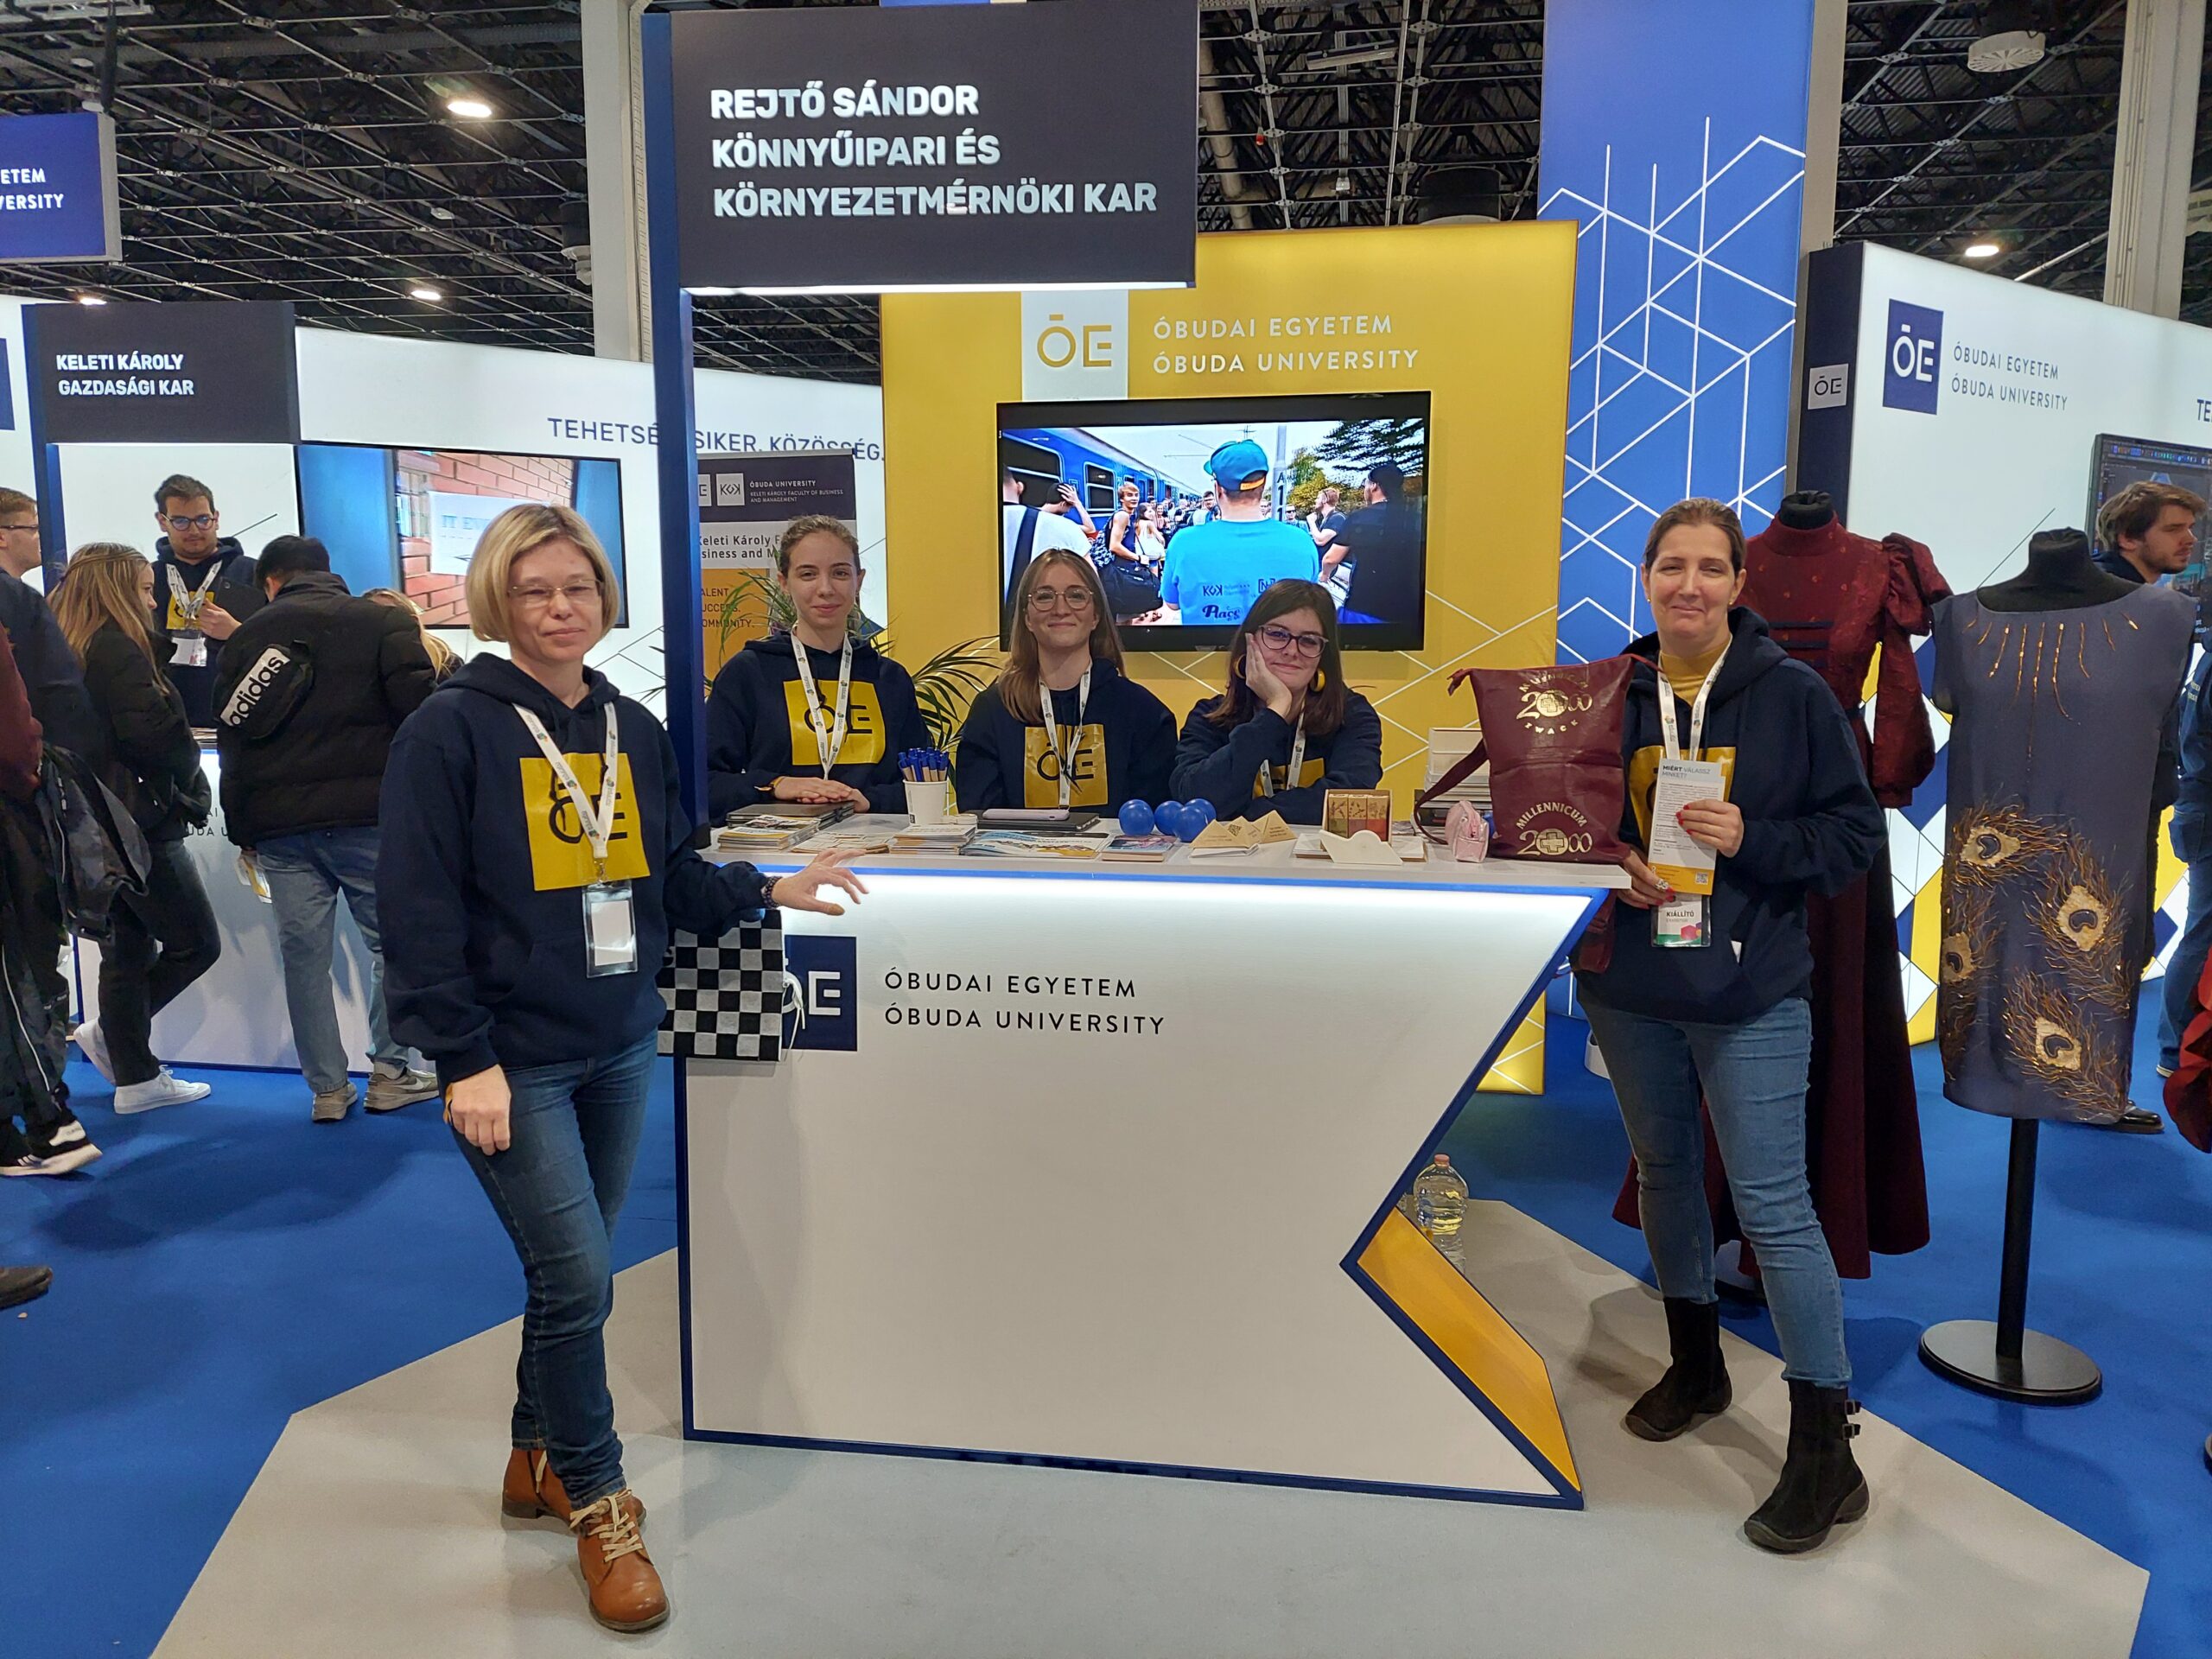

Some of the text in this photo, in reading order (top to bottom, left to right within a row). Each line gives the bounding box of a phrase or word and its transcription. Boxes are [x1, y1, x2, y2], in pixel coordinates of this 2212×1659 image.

[710, 79, 979, 119] REJTŐ SÁNDOR
[712, 129, 1001, 168] KÖNNYŰIPARI ÉS
[0, 168, 46, 184] ETEM
[714, 178, 1157, 217] KÖRNYEZETMÉRNÖKI KAR
[1154, 315, 1392, 340] ÓBUDAI EGYETEM
[56, 351, 183, 370] KELETI KÁROLY
[1154, 349, 1419, 373] ÓBUDA UNIVERSITY
[1954, 341, 2058, 380] ÓBUDAI EGYETEM
[58, 377, 194, 395] GAZDASÁGI KAR
[1951, 372, 2068, 410] ÓBUDA UNIVERSITY
[547, 417, 659, 446] TEHETSÉ
[702, 549, 737, 558] siness
[741, 548, 762, 558] and
[733, 535, 770, 547] Károly
[230, 657, 283, 725] adidas
[1524, 720, 1578, 734] ZWACK
[1516, 802, 1587, 830] MILLENNICUM
[188, 827, 214, 836] UDA
[885, 967, 1135, 998] ÓBUDAI EGYETEM
[885, 1002, 1165, 1035] ÓBUDA UNIVERSITY
